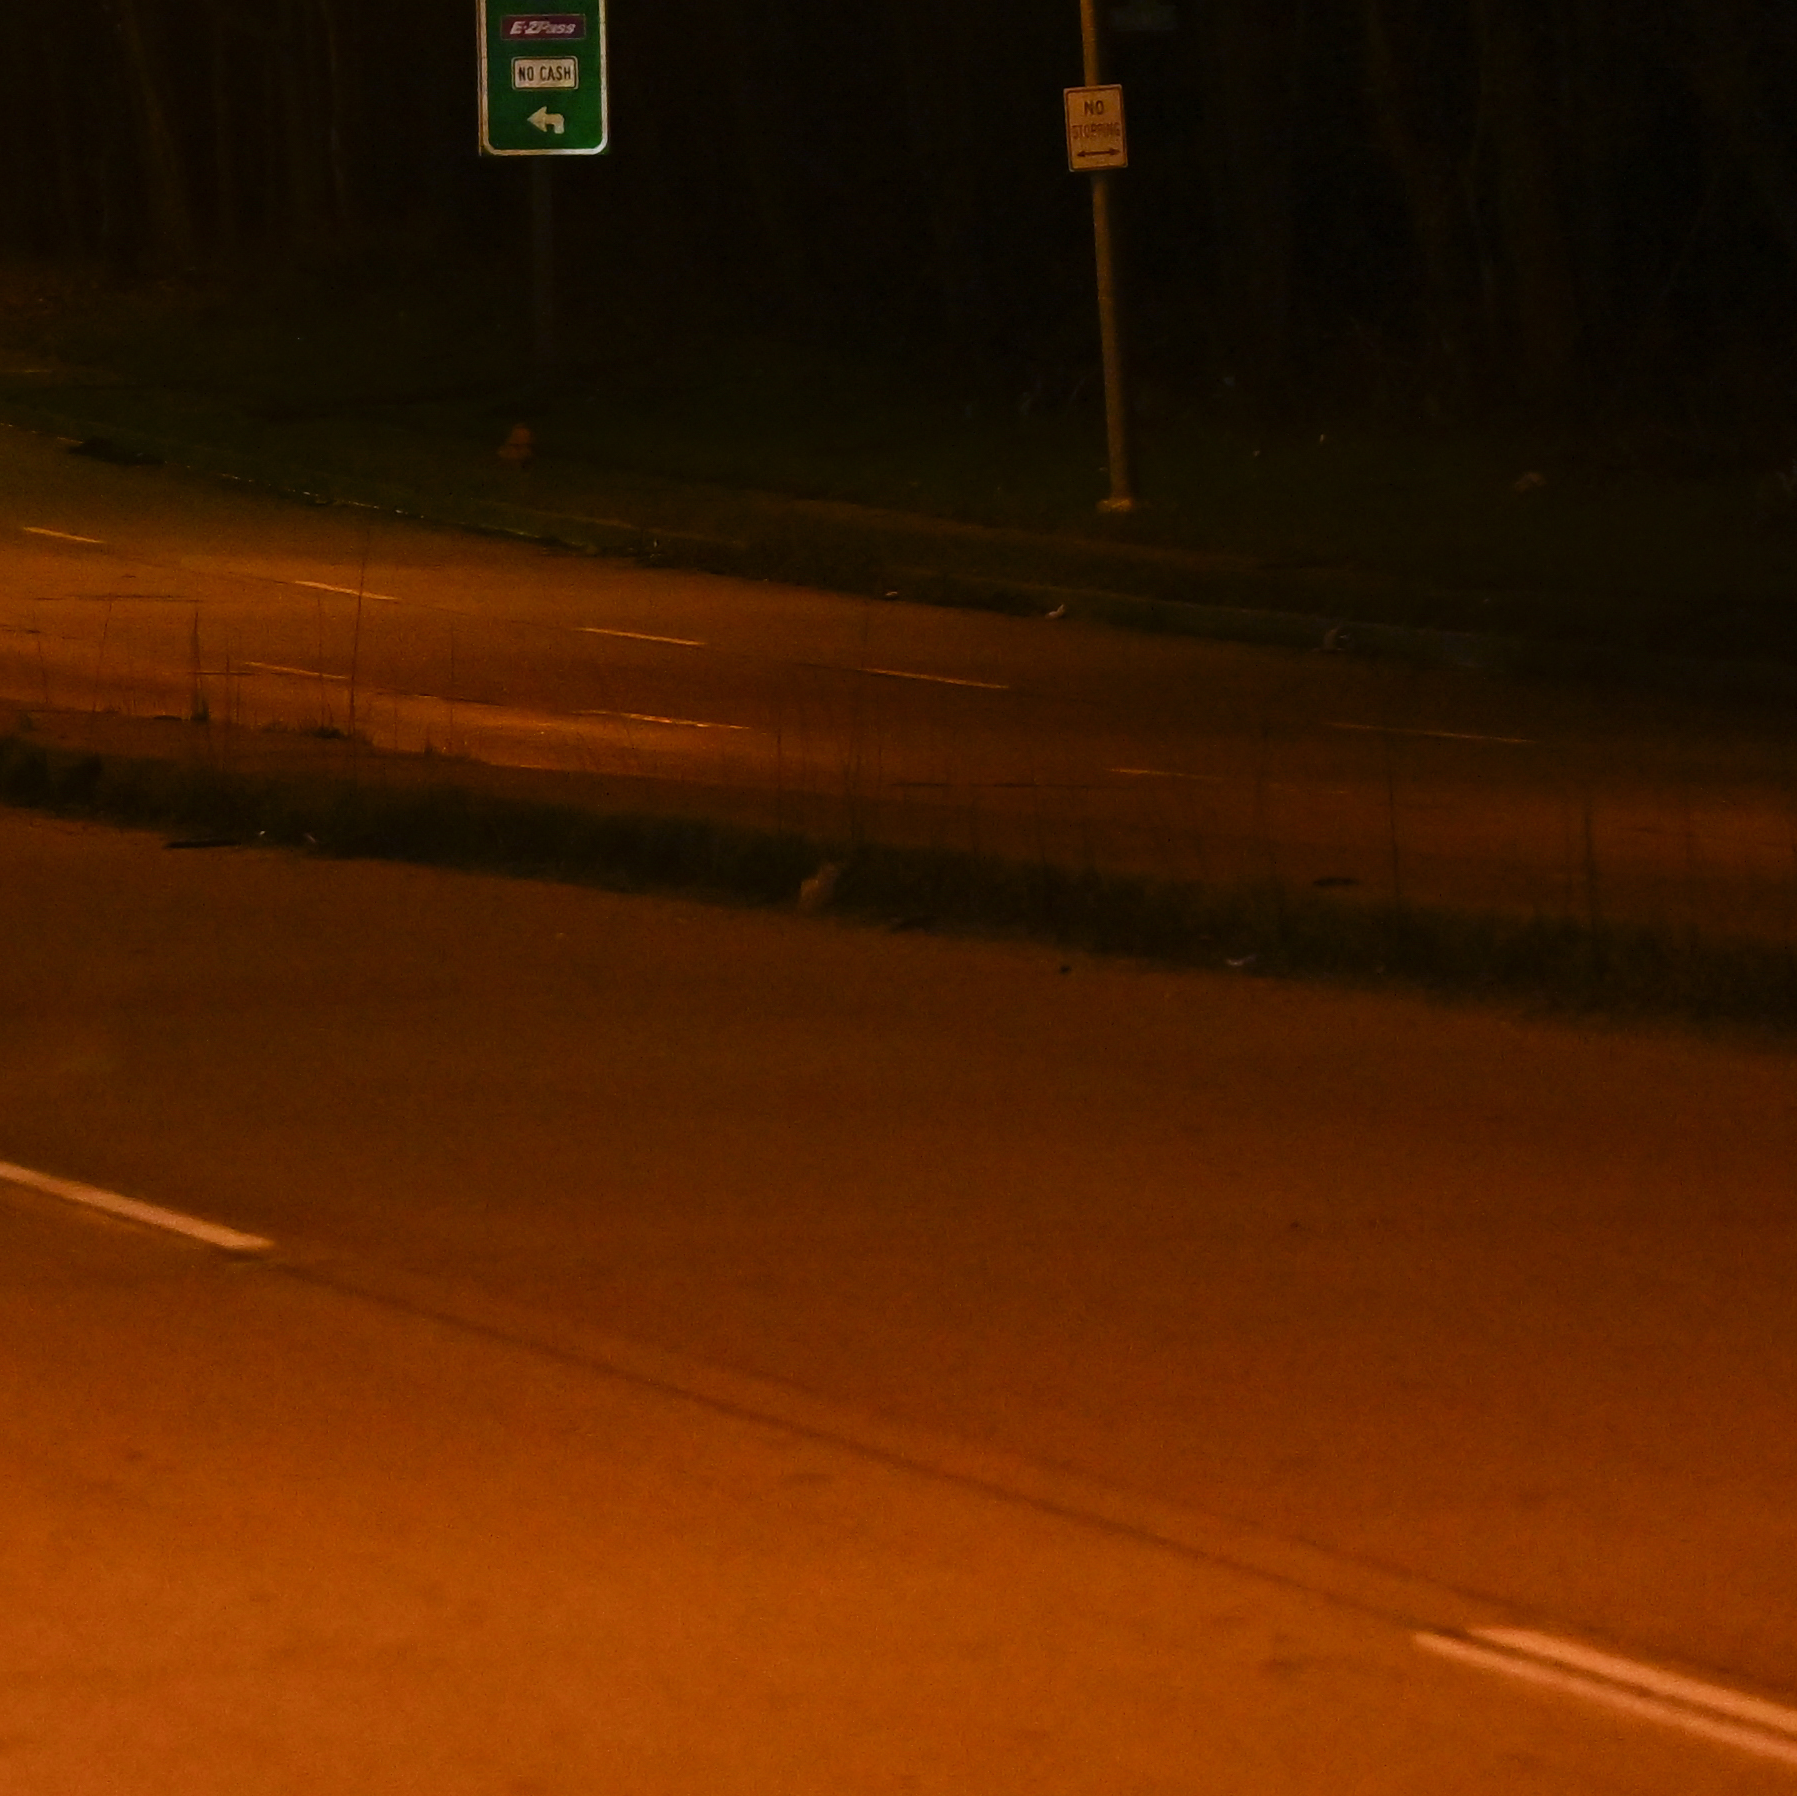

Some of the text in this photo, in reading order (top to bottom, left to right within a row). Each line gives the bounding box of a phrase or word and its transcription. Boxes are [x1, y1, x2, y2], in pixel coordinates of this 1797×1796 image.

[517, 65, 572, 82] NO CASH
[1084, 100, 1105, 115] NO
